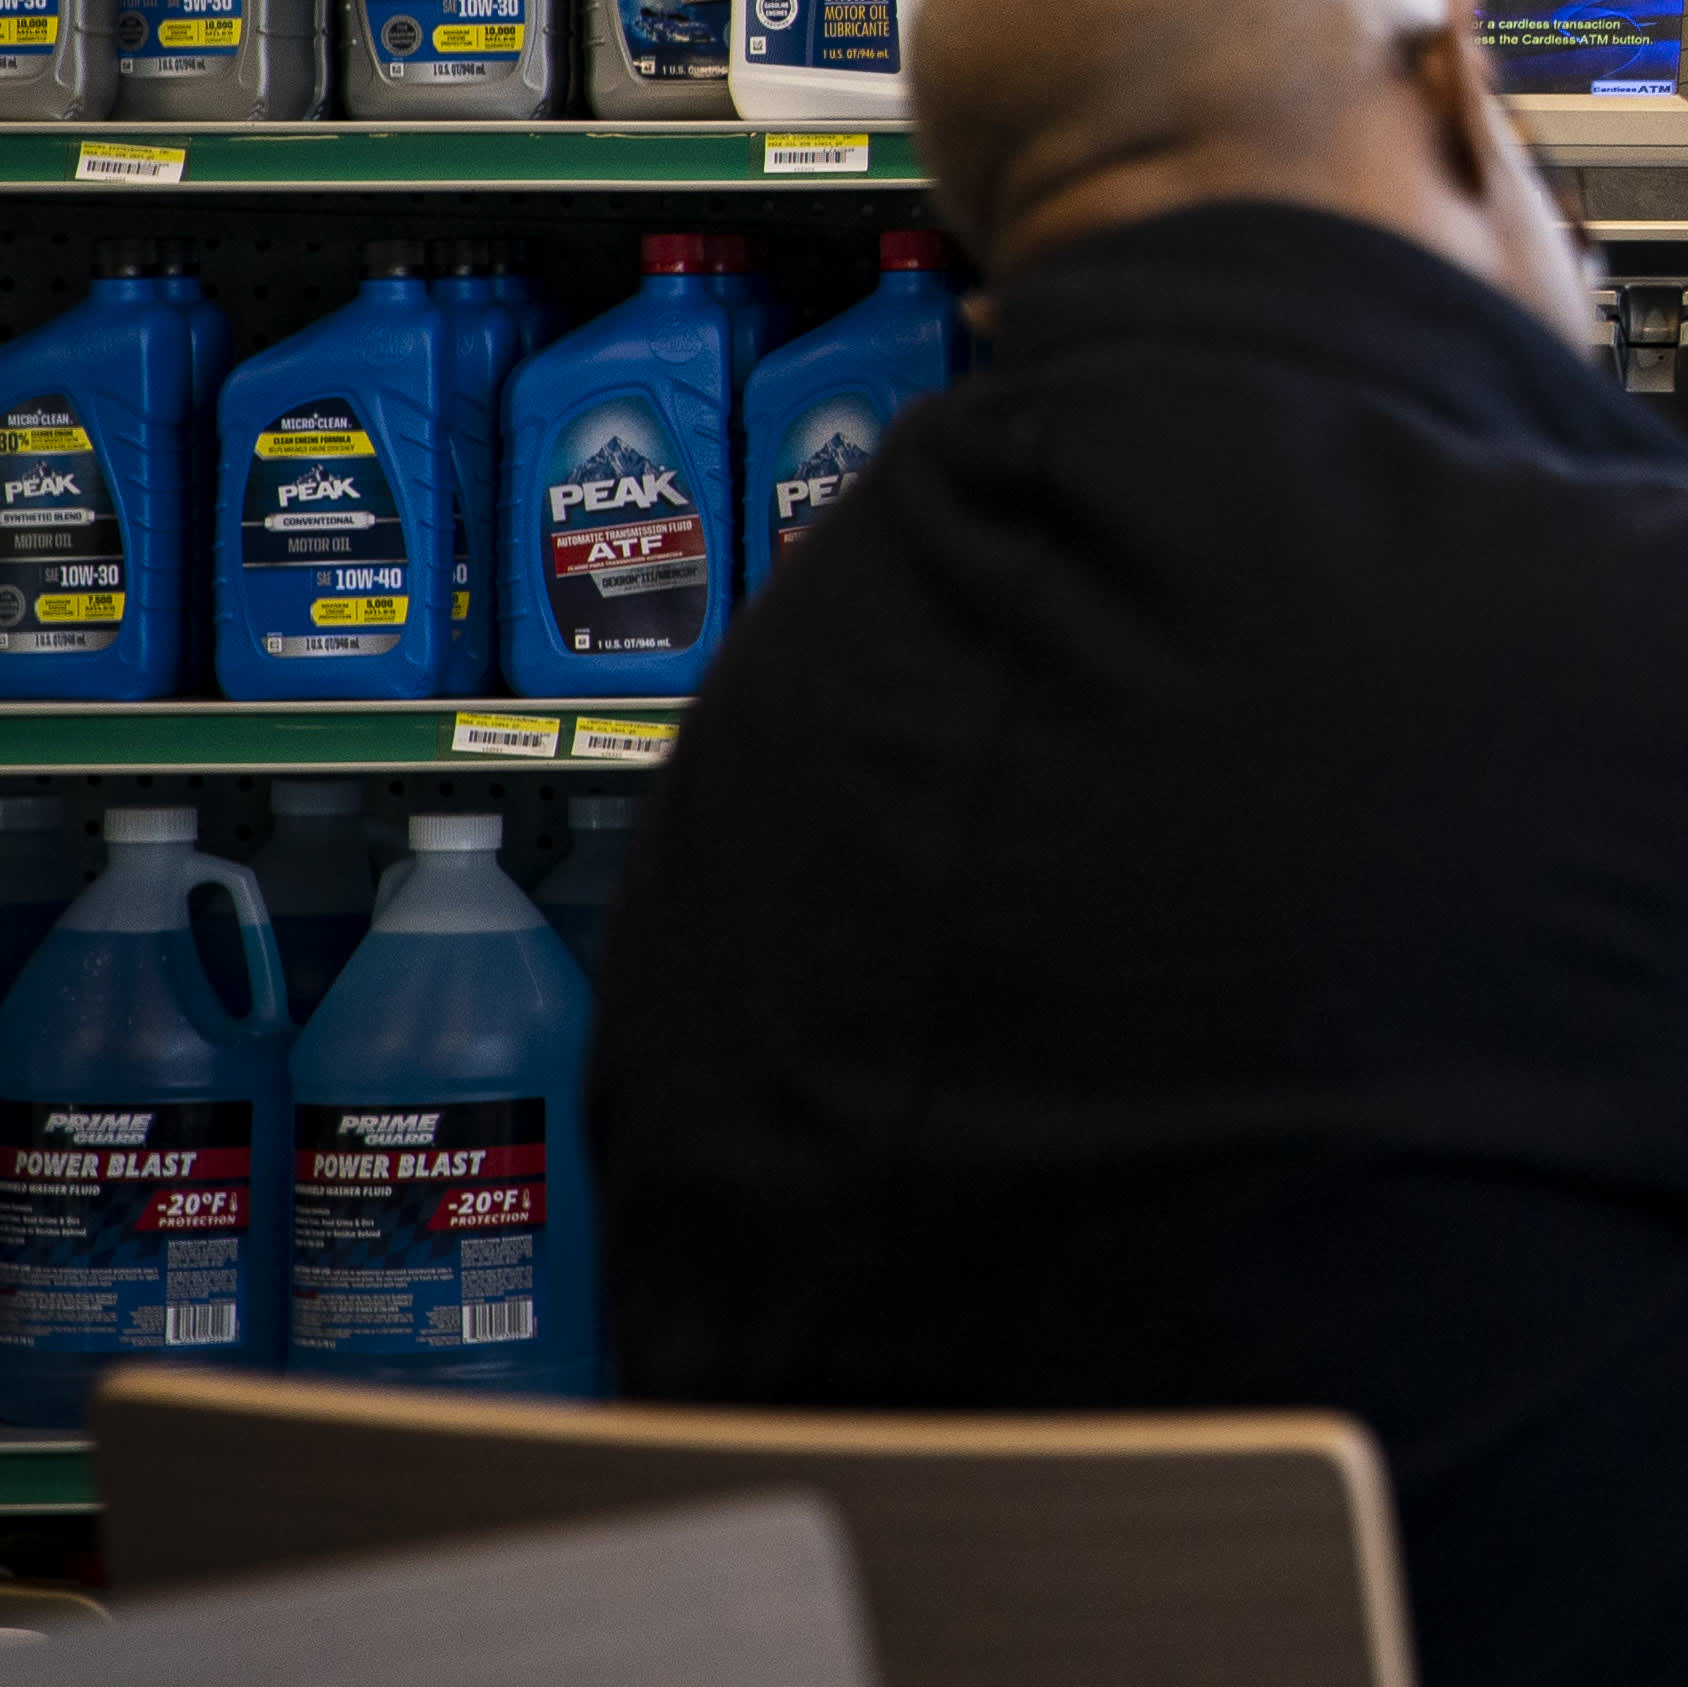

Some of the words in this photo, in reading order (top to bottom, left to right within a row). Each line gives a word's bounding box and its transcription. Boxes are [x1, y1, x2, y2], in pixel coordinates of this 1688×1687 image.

[825, 6, 866, 21] MOTOR
[870, 6, 888, 20] OIL
[825, 22, 889, 38] LUBRICANTE
[278, 477, 360, 507] PEAK
[550, 471, 688, 521] PEAK
[588, 535, 663, 562] ATF
[336, 568, 401, 590] 10W-40
[313, 1154, 389, 1179] POWER
[398, 1151, 486, 1178] BLAST
